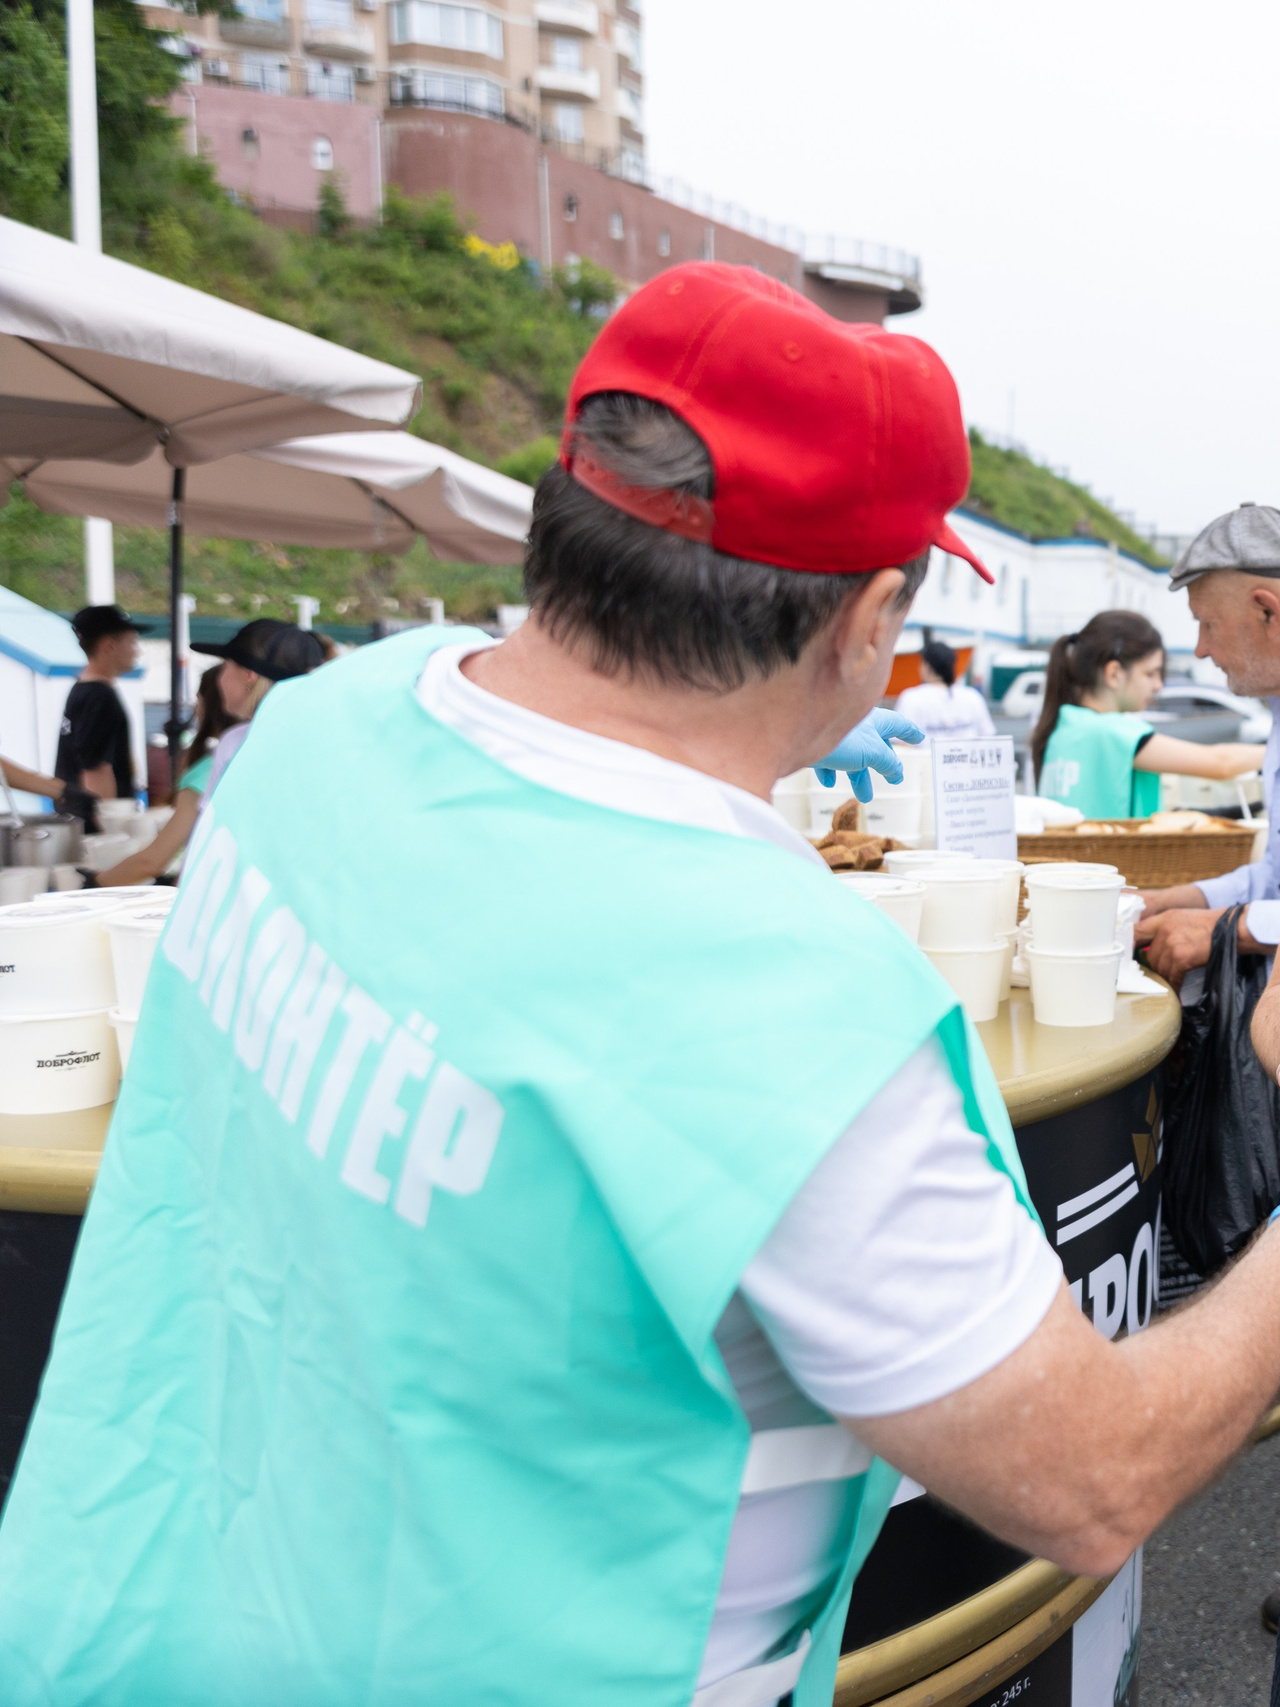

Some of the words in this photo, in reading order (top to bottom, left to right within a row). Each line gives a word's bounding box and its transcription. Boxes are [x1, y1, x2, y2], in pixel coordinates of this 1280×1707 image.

[163, 803, 505, 1229] ОЛОНТЁР
[36, 1052, 101, 1068] ДОБРОФЛОТ
[1002, 1680, 1022, 1706] 245
